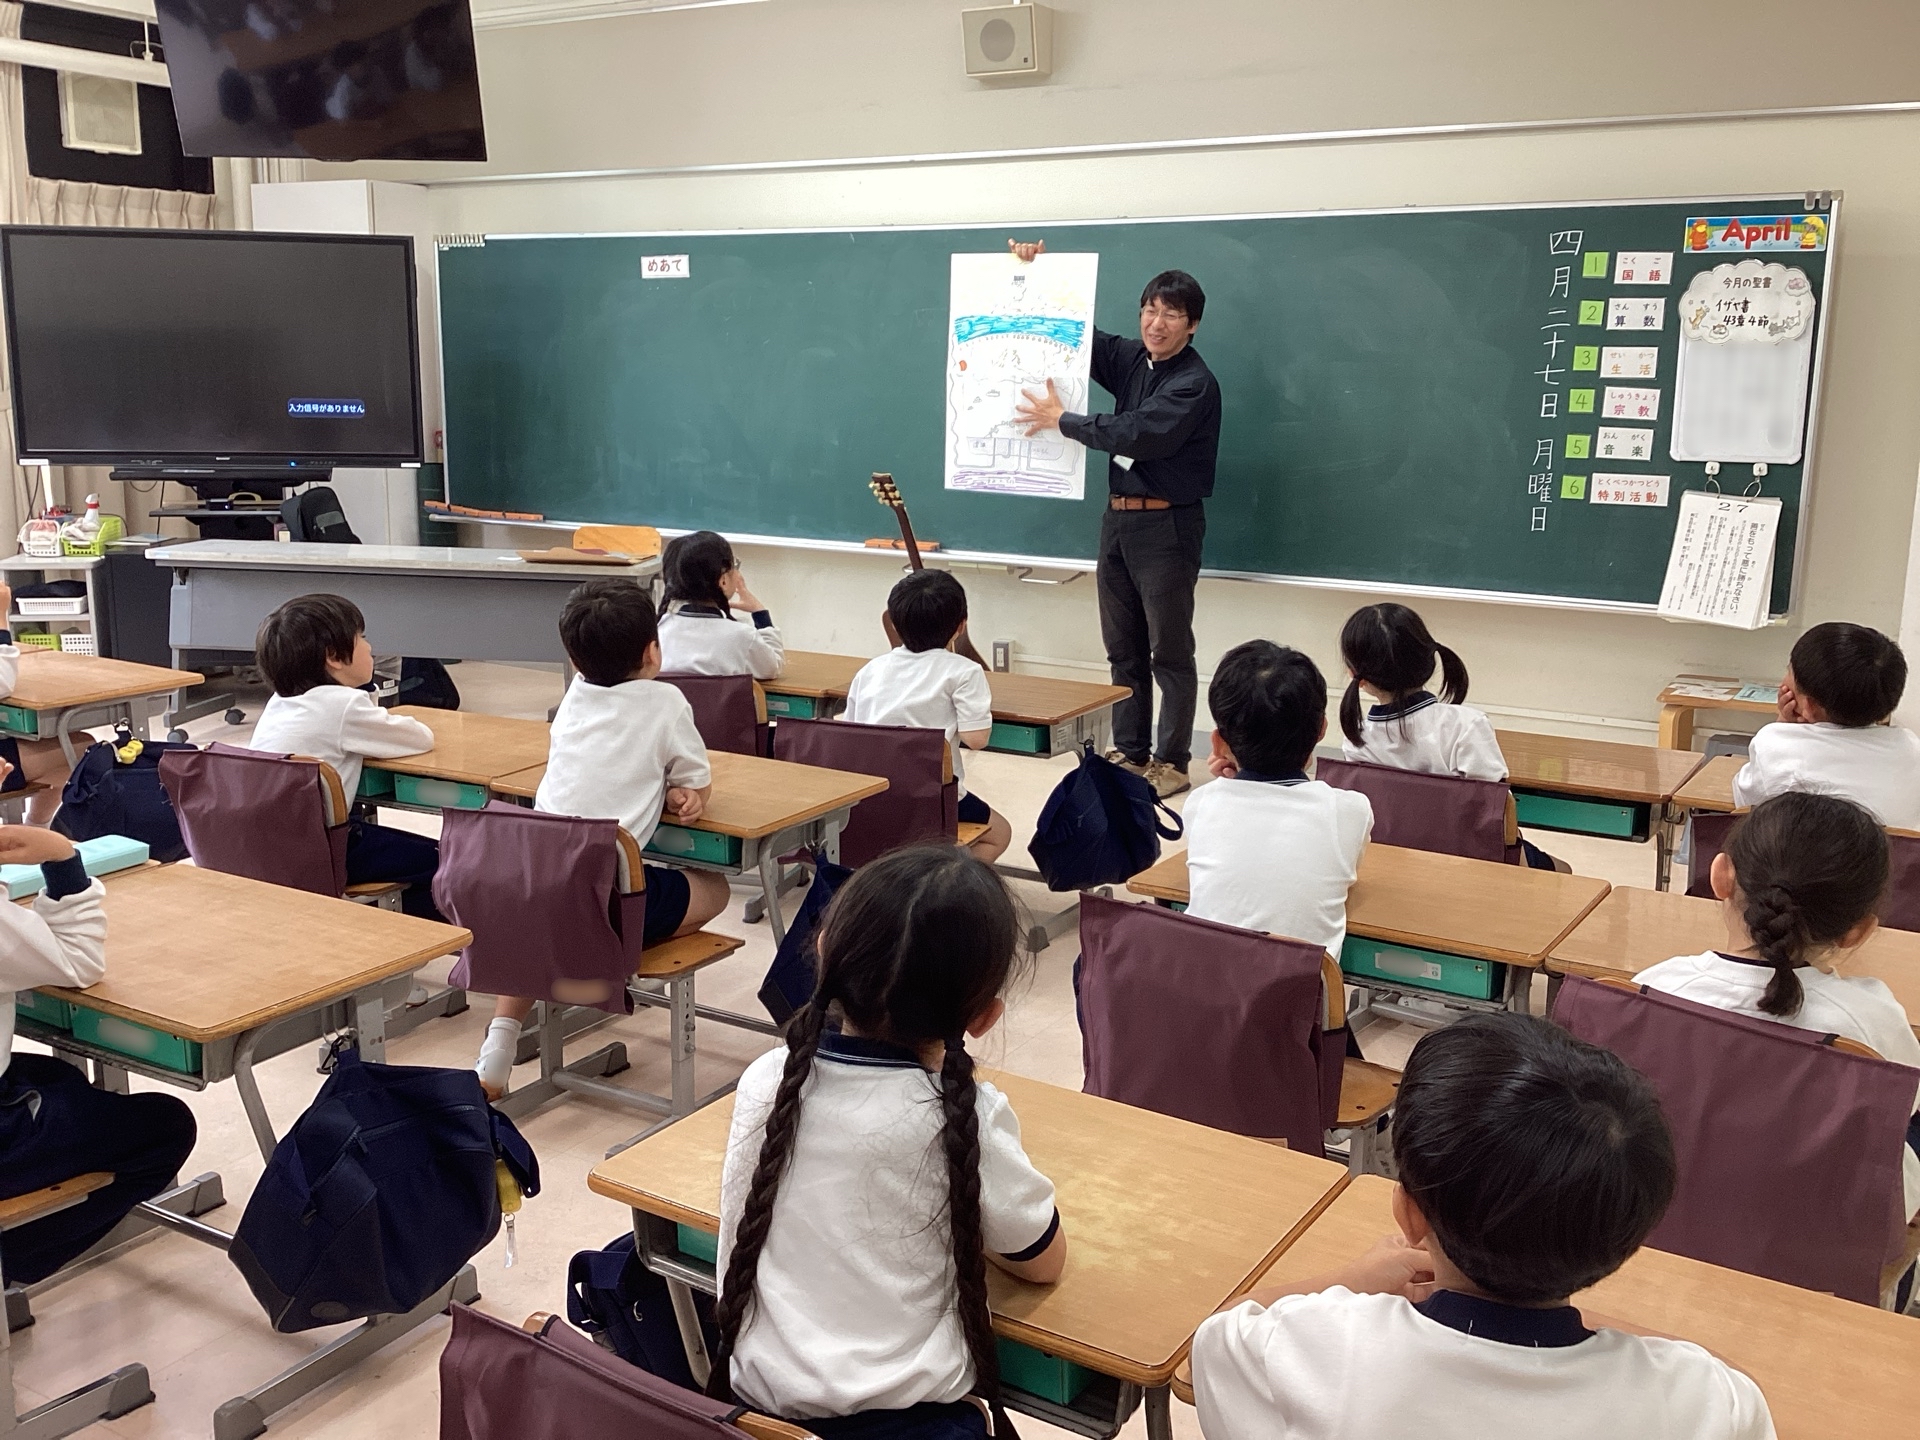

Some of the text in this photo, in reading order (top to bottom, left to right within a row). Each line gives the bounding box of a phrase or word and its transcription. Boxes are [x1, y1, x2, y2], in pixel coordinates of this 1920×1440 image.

[1721, 217, 1792, 250] April
[647, 258, 682, 272] めあて
[1622, 269, 1661, 282] 国語
[1723, 276, 1772, 289] 今月の聖書
[1715, 297, 1751, 313] イザヤ書
[1586, 305, 1597, 321] 2
[1614, 315, 1656, 327] 算数
[1582, 350, 1591, 365] 3
[1611, 364, 1651, 375] 生活
[1528, 230, 1584, 532] 四月二十七日 月曜日
[1575, 393, 1588, 409] 4
[1610, 391, 1657, 401] しゅうきょう
[288, 403, 365, 414] 入力信号がありません
[1614, 404, 1650, 417] 宗教
[1573, 439, 1582, 455] 5
[1603, 444, 1643, 457] 音楽
[1569, 480, 1580, 495] 6
[1597, 478, 1660, 487] とくべつかつどう
[1597, 490, 1658, 503] 特別活動
[1730, 522, 1758, 613] をもってに勝ちなさい。
